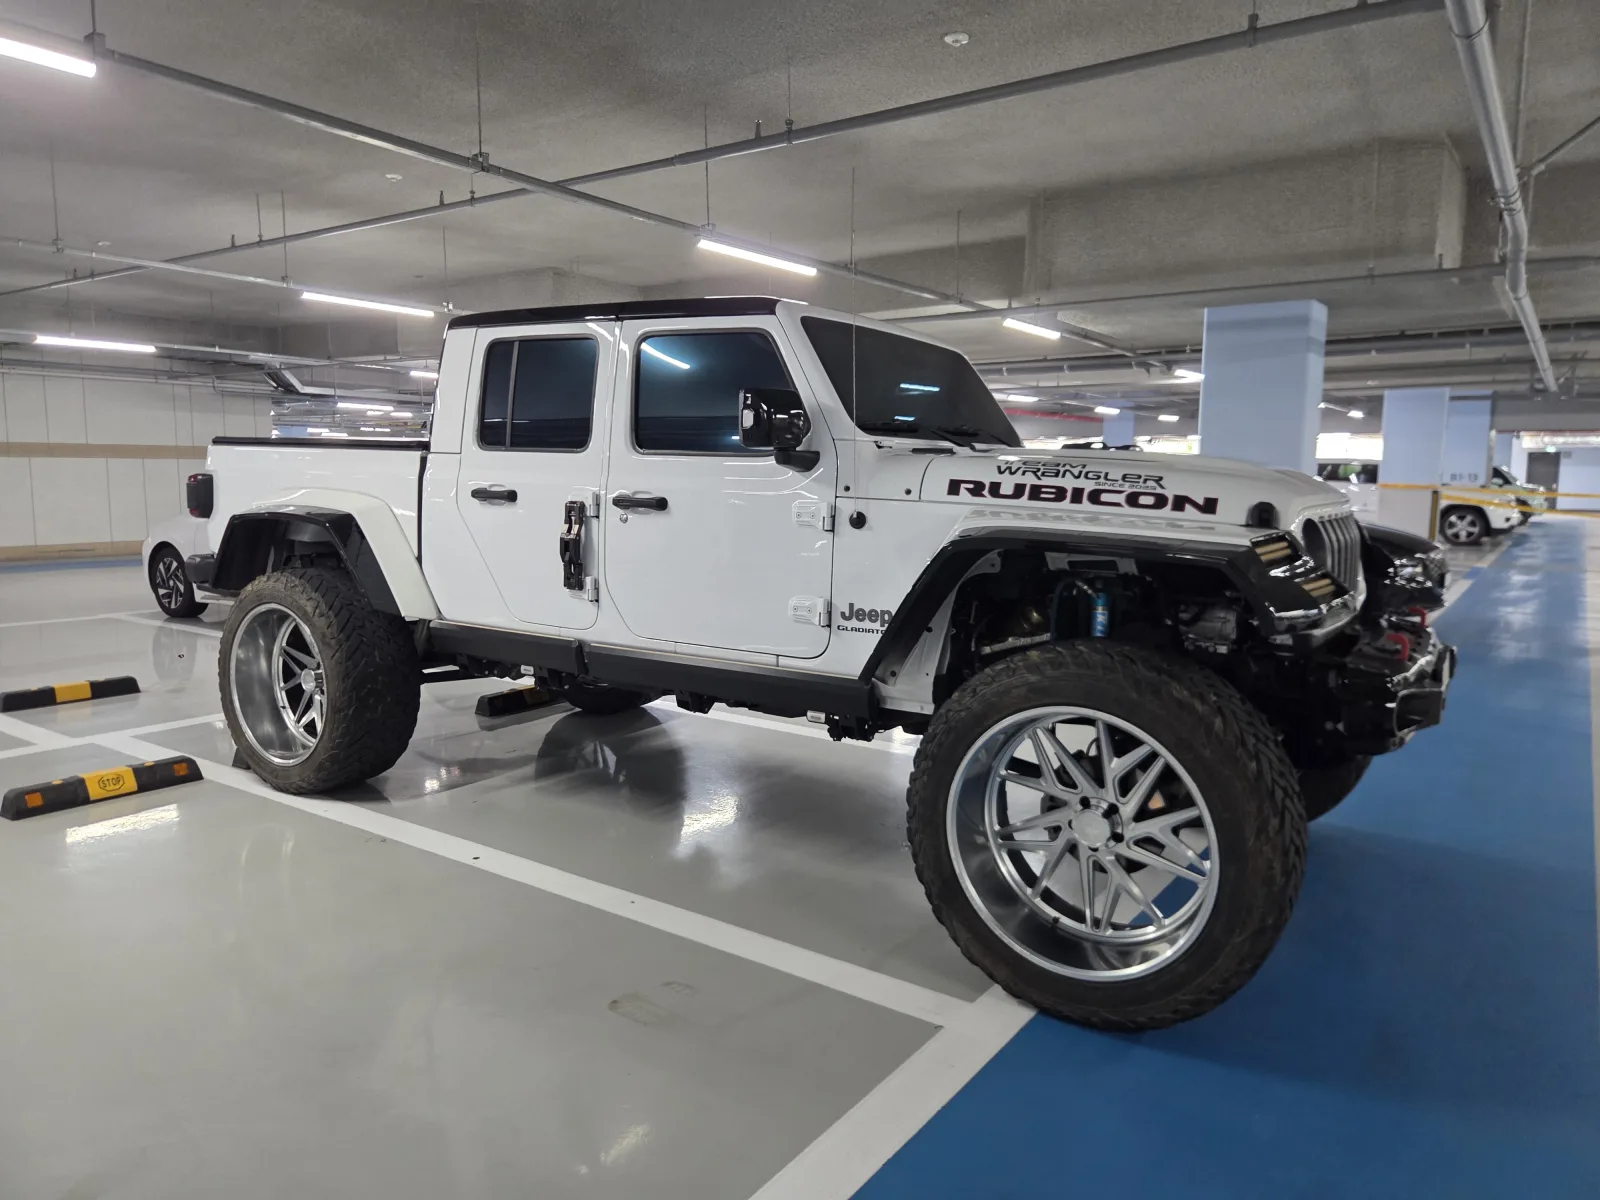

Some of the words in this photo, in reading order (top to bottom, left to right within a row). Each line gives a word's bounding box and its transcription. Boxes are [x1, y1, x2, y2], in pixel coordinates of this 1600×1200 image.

[996, 465, 1167, 491] WRANGLER
[1093, 481, 1125, 489] SINCE
[946, 478, 1219, 516] RUBICON
[840, 602, 894, 628] Jeep
[837, 625, 887, 635] GLADIATO
[101, 776, 121, 788] STOP
